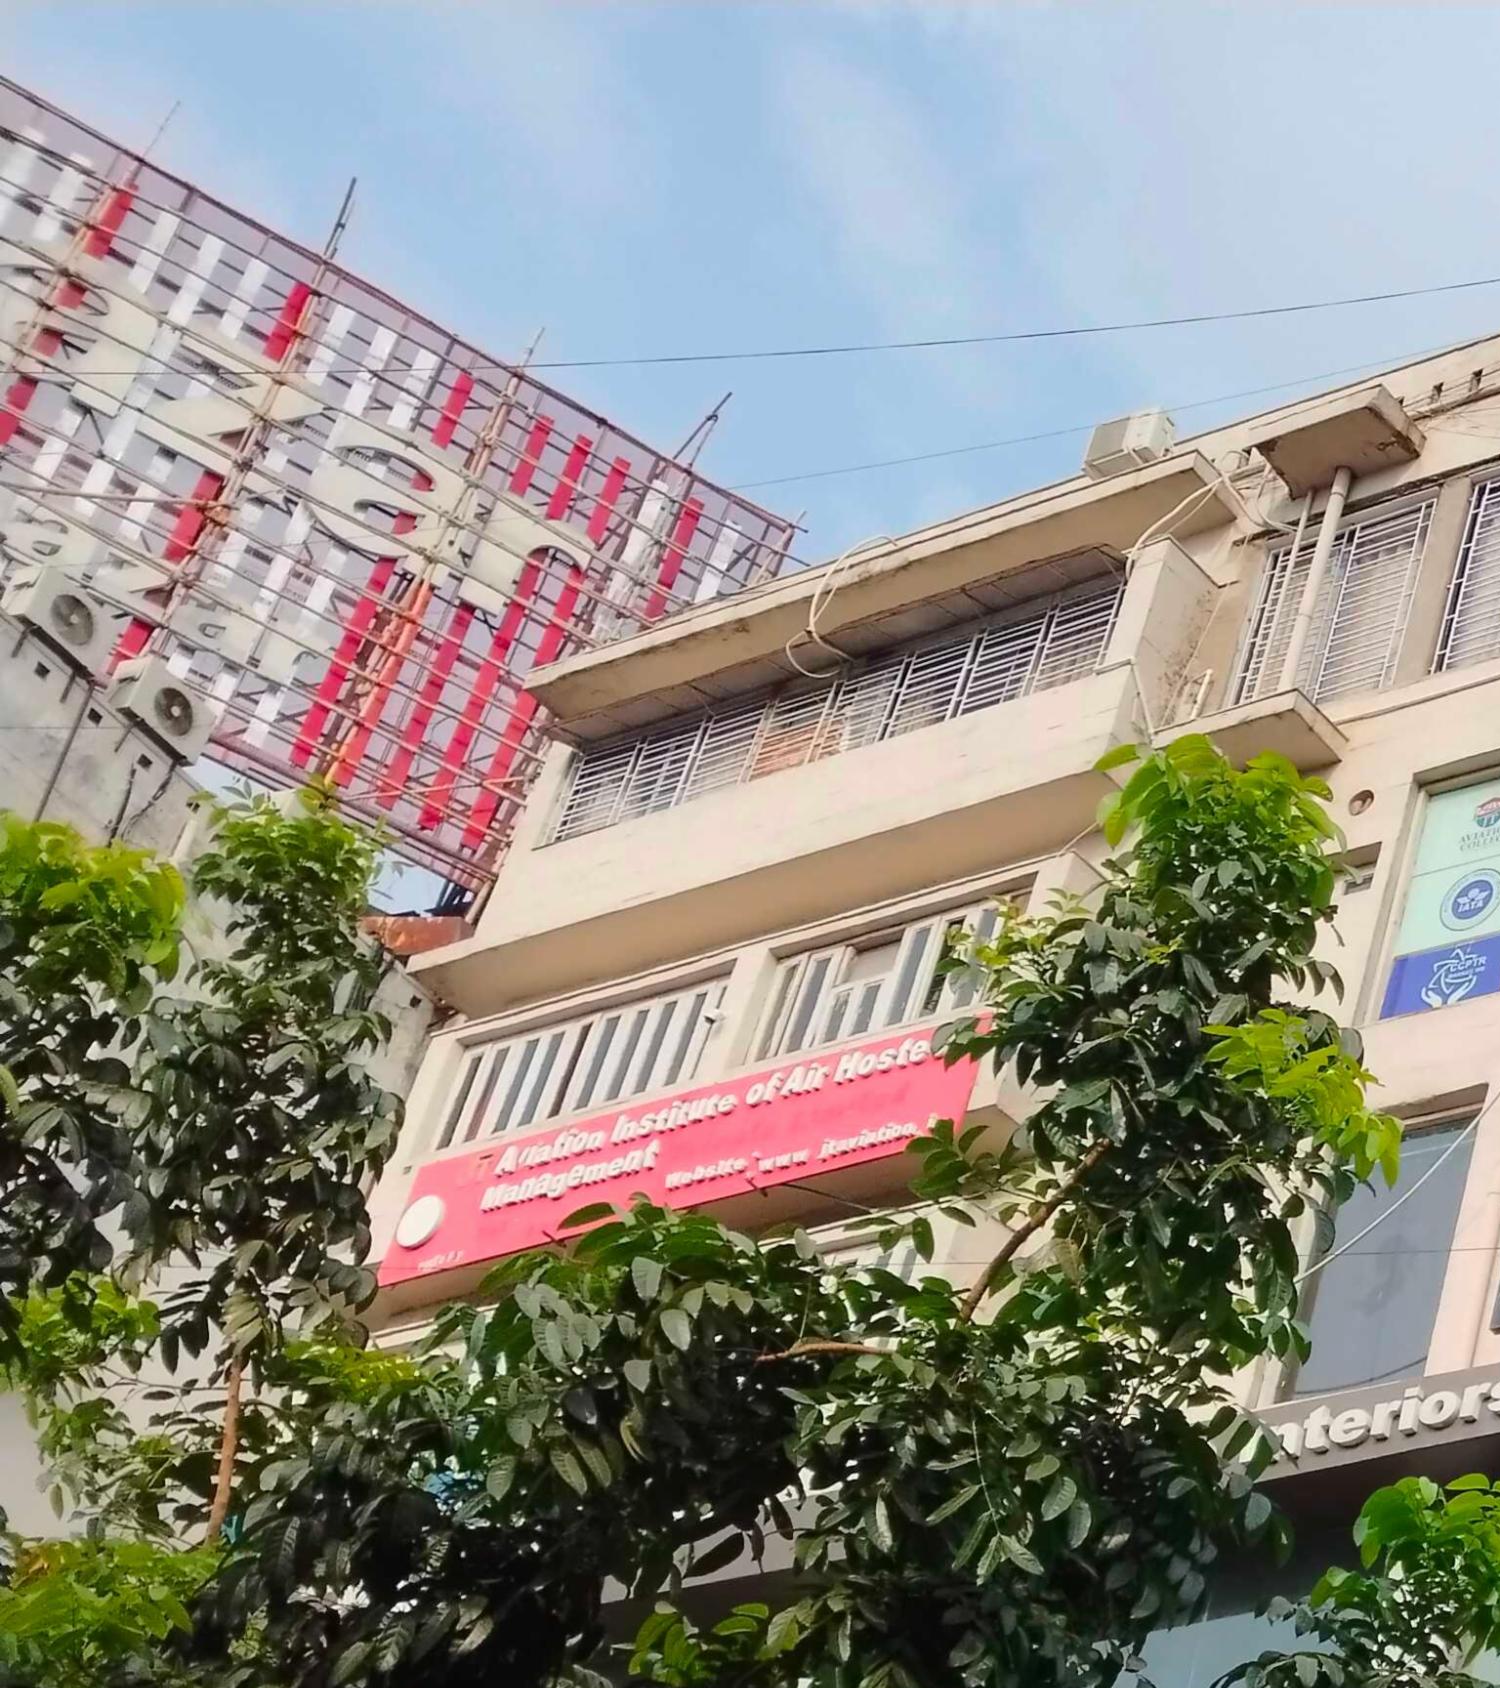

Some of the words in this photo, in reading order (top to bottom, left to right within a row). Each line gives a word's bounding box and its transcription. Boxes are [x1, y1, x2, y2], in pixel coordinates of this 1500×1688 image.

[1457, 900, 1484, 913] IATA
[609, 1091, 738, 1147] Institute
[778, 1062, 831, 1100] Air
[479, 1138, 662, 1214] Management
